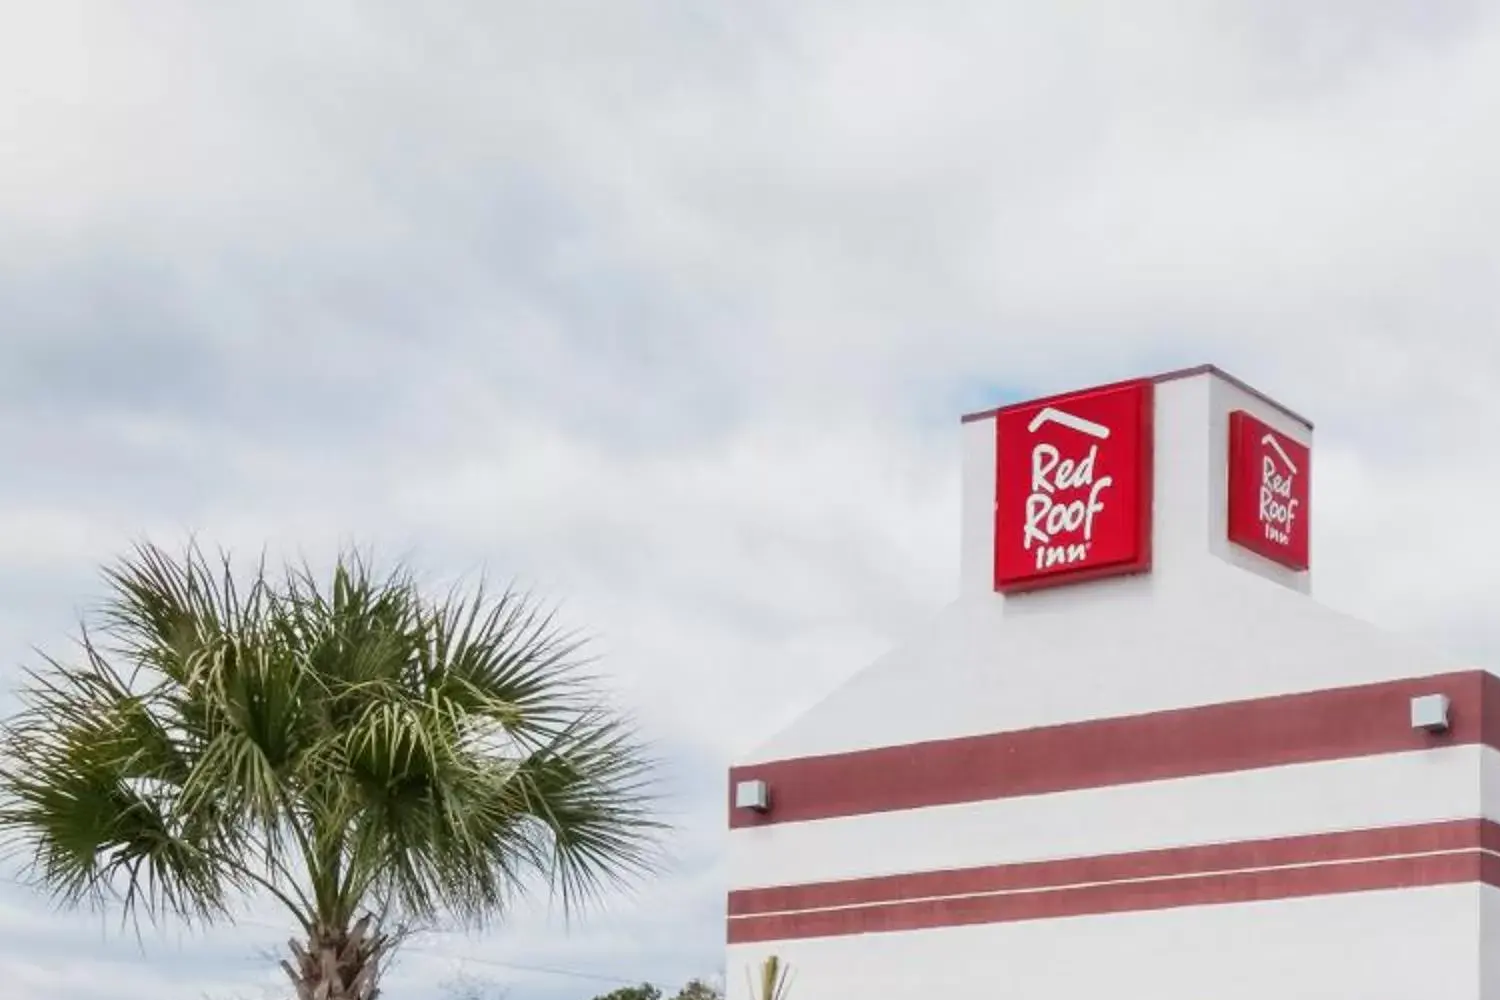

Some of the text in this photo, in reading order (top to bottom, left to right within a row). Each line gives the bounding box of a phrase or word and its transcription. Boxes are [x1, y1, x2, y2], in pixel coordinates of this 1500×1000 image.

[1032, 443, 1098, 493] Red
[1263, 455, 1292, 498] Red
[1024, 476, 1112, 549] Roof
[1259, 485, 1298, 533] Roof
